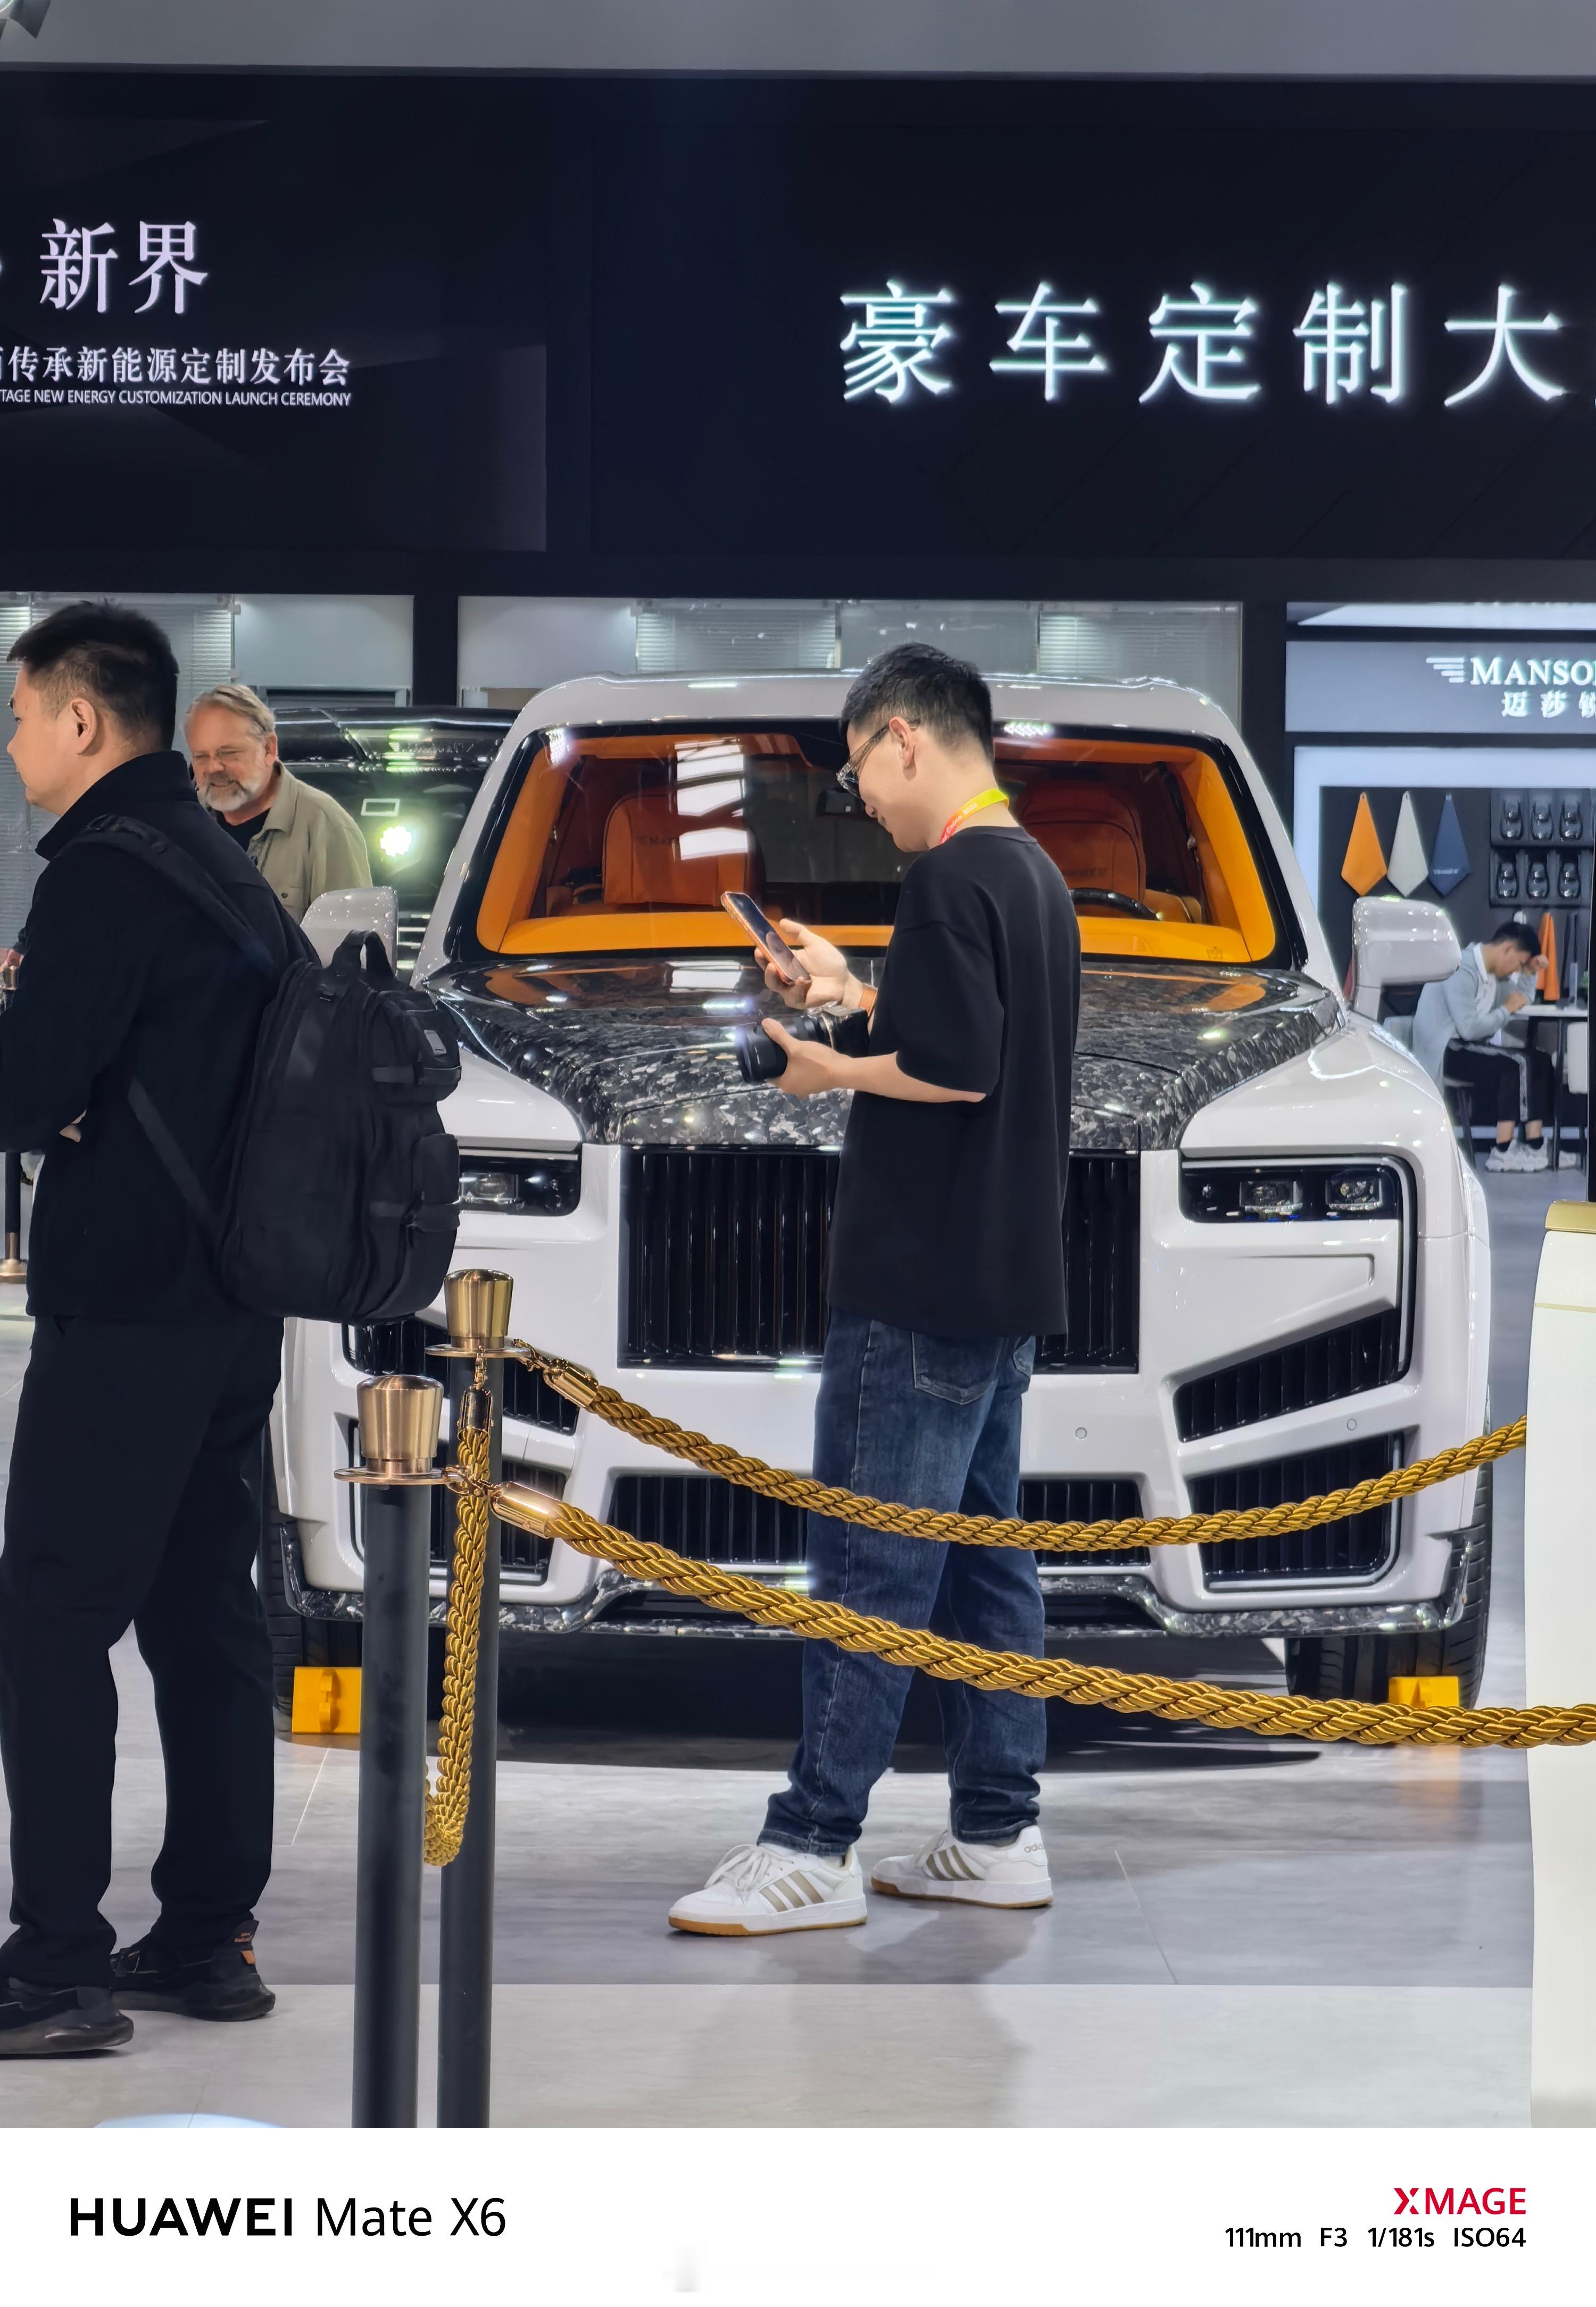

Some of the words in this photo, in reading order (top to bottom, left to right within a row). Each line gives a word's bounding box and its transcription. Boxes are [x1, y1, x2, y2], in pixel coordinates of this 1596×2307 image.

[40, 218, 208, 314] 新界
[839, 279, 1568, 408] 豪车定制大
[0, 346, 351, 386] 传承新能源定制发布会
[34, 389, 64, 403] NEW
[68, 389, 115, 404] ENERGY
[119, 390, 222, 405] CUSTOMIZATION
[226, 392, 278, 405] LAUNCH
[281, 392, 352, 406] CEREMONY
[1470, 657, 1596, 686] MANSO
